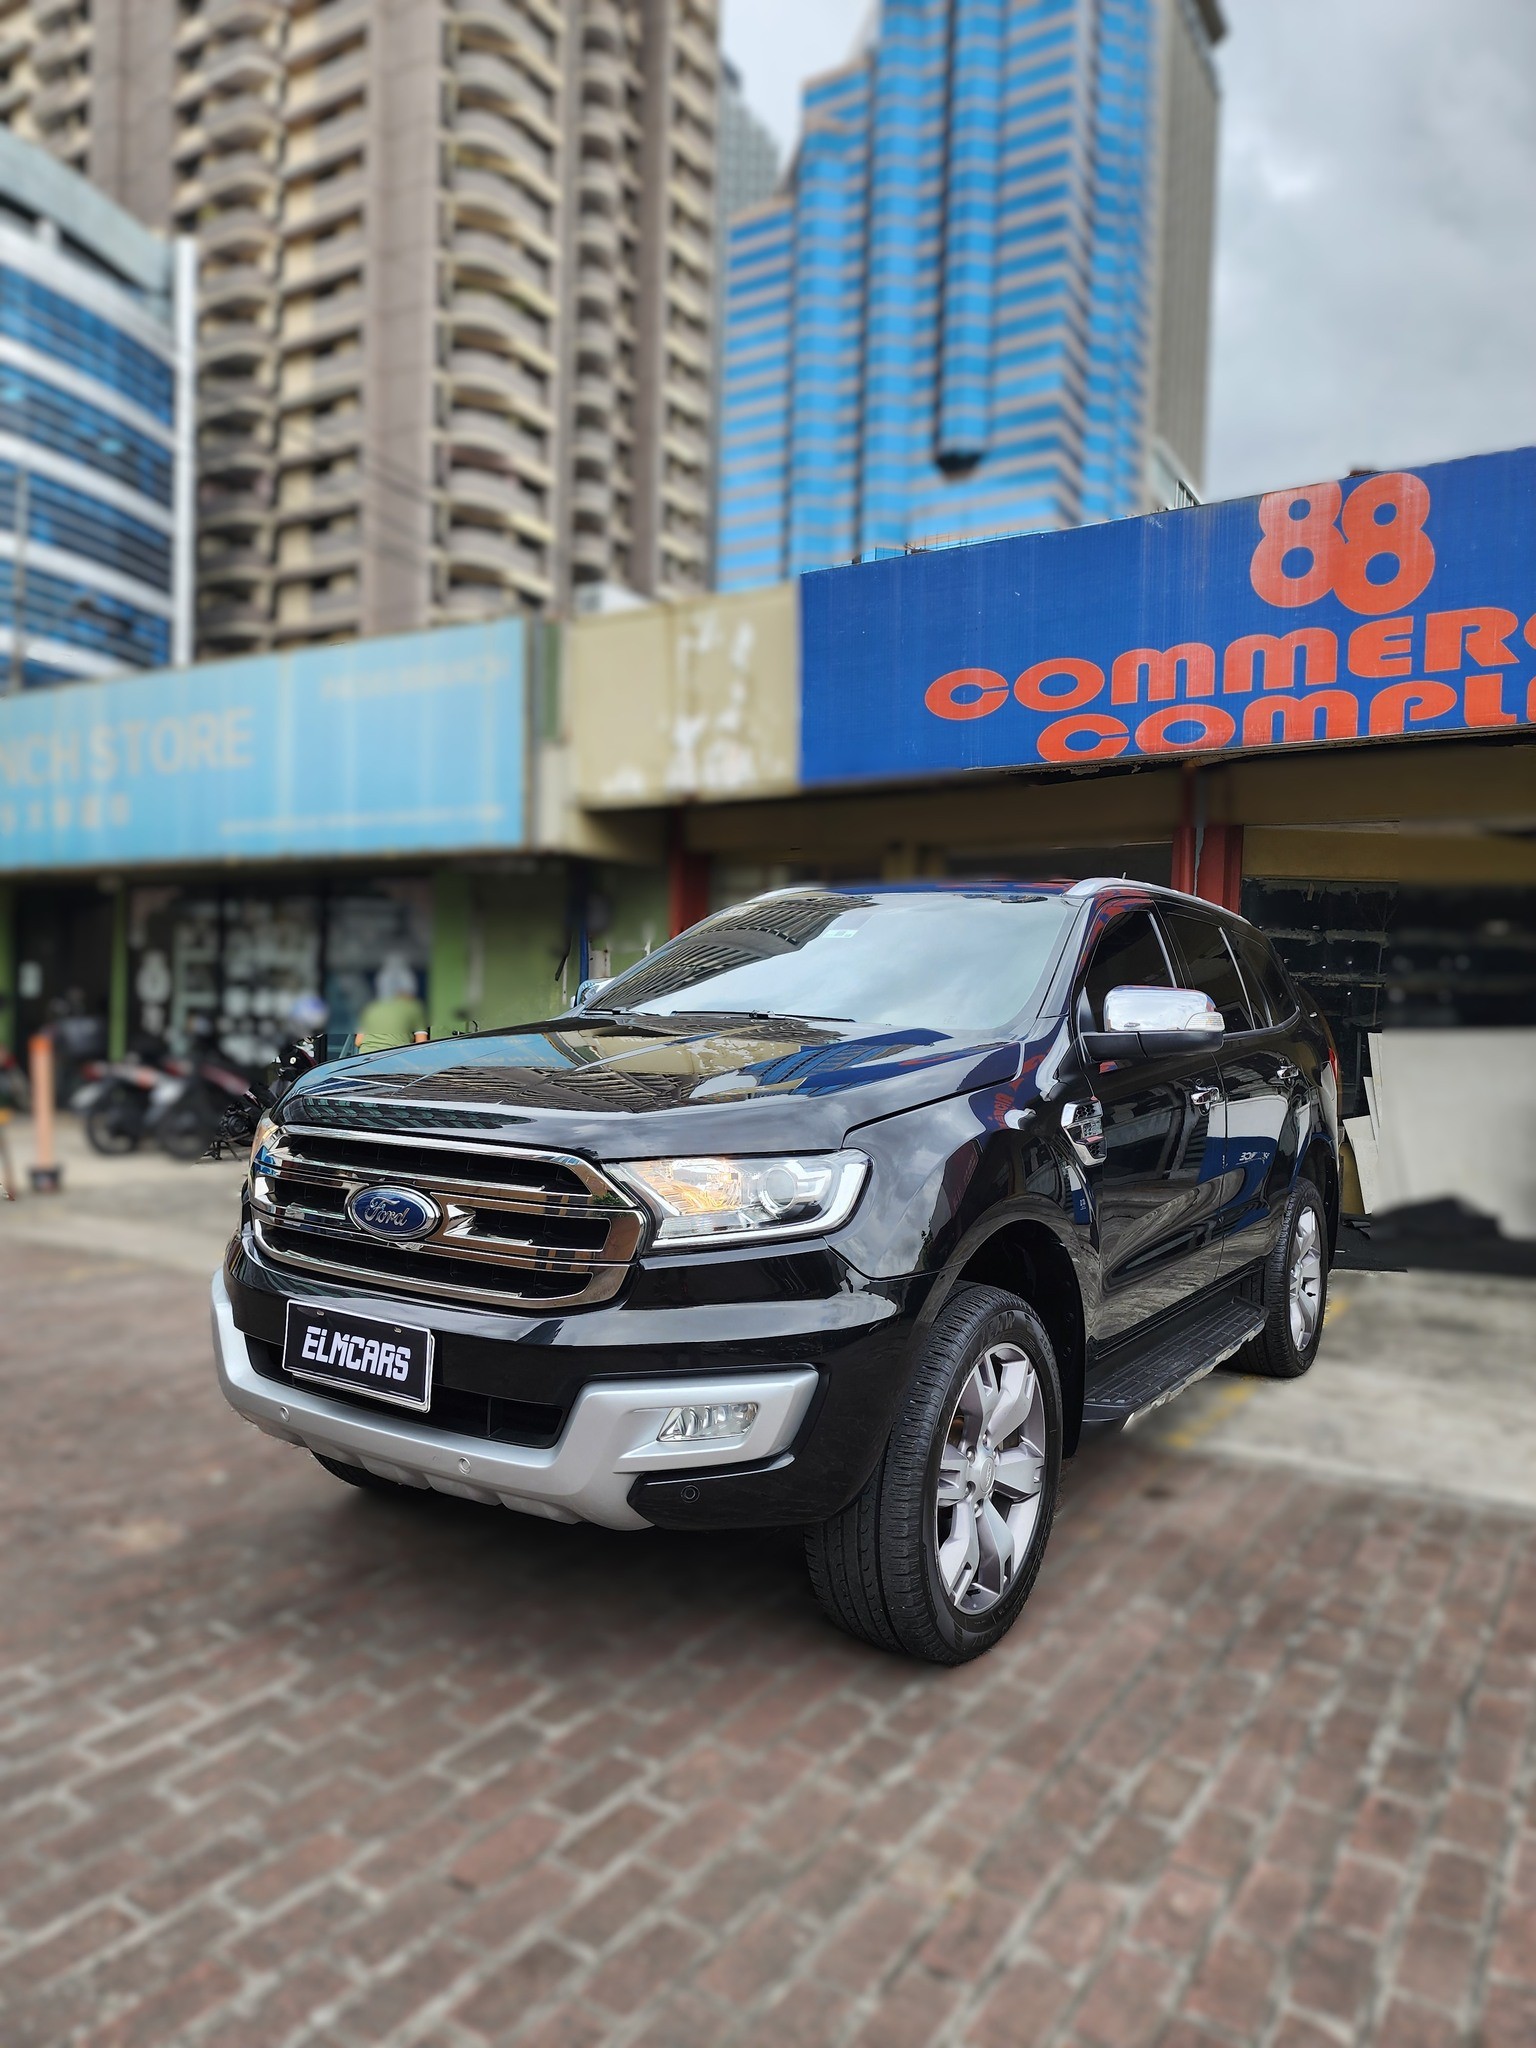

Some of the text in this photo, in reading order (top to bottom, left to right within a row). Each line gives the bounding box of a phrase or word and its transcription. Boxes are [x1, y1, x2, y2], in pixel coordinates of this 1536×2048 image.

[1250, 472, 1436, 615] 88
[924, 606, 1536, 721] COMMER
[90, 707, 254, 783] STORE
[1036, 671, 1536, 763] COMPL
[364, 1196, 411, 1227] Ford
[301, 1325, 411, 1382] ELMCARS
